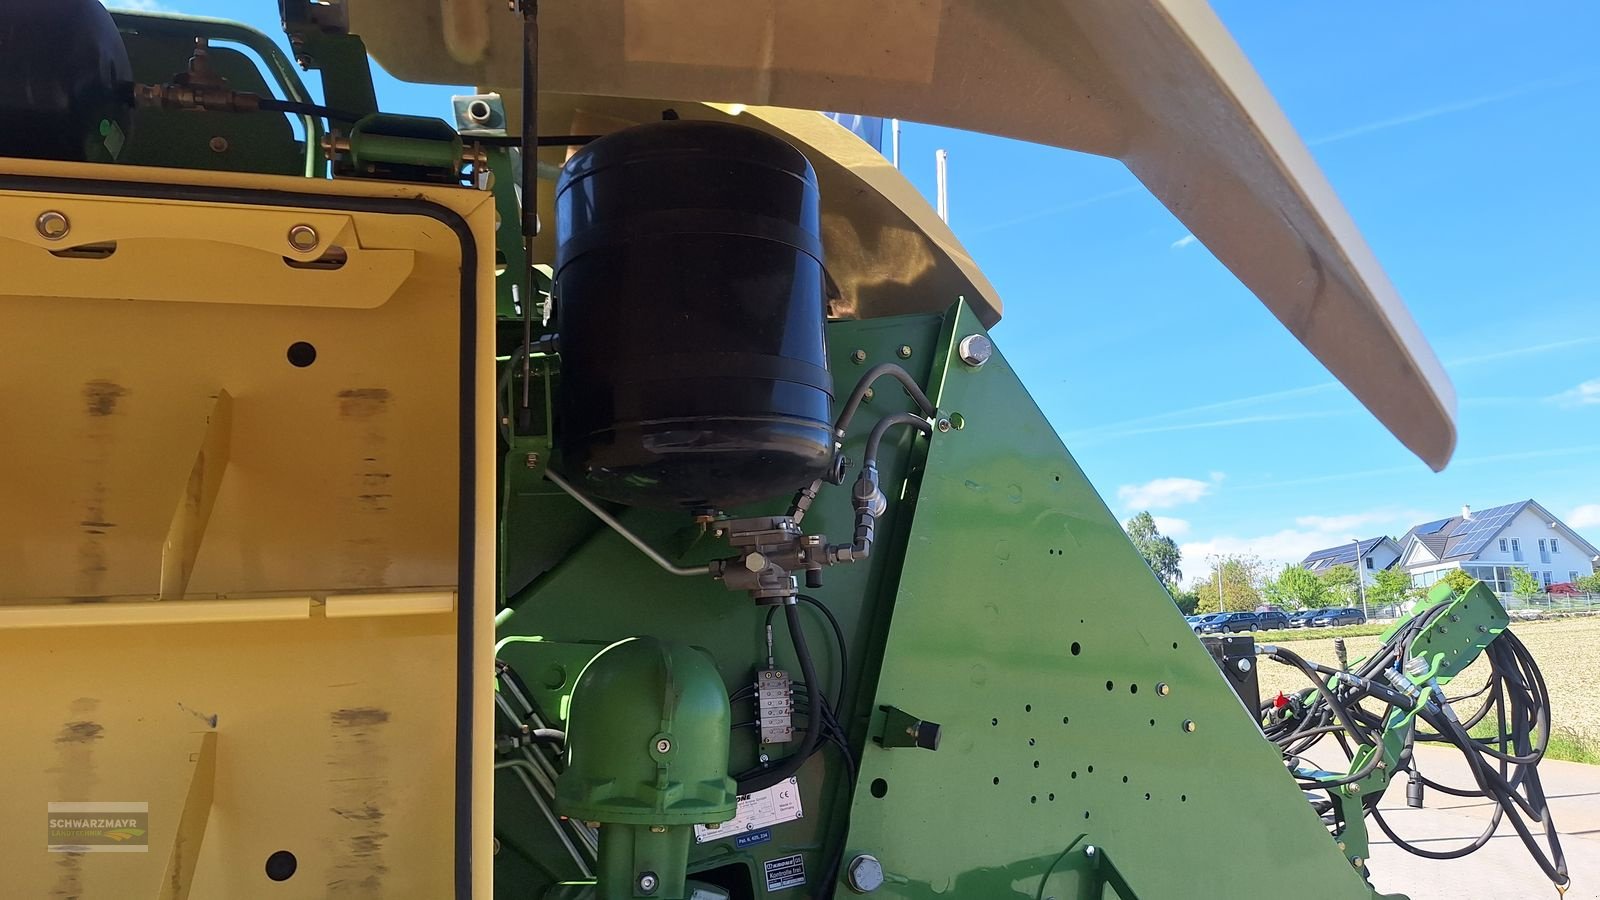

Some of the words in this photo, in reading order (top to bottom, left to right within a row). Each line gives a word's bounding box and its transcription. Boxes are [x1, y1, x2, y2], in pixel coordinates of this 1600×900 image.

[785, 727, 790, 735] 5
[773, 859, 793, 868] KRONE
[769, 868, 792, 879] Kontrolle
